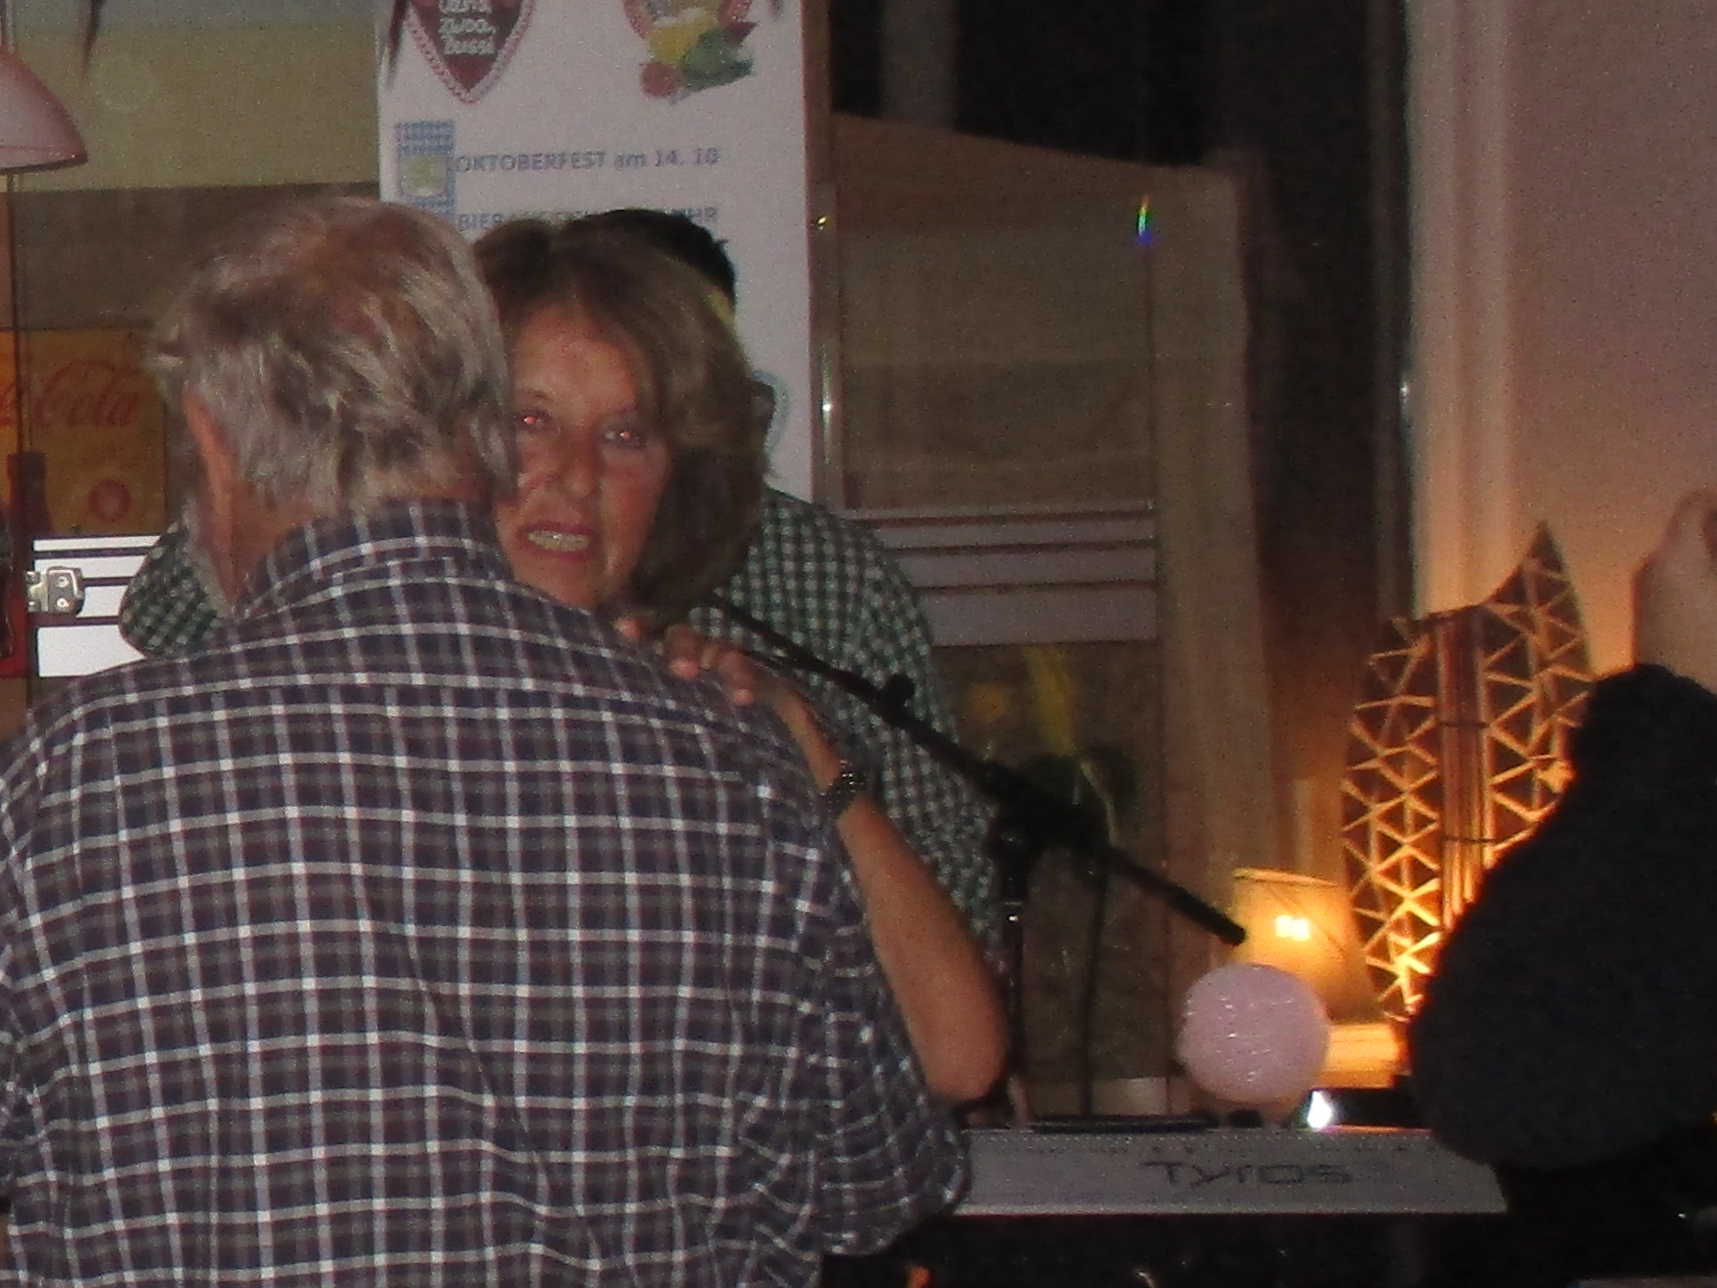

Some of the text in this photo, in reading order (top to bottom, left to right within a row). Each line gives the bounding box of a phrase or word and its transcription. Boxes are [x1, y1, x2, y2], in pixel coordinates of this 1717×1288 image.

[455, 151, 606, 173] OKTOBERFEST
[613, 152, 647, 169] am
[1140, 1160, 1355, 1189] Tyros
